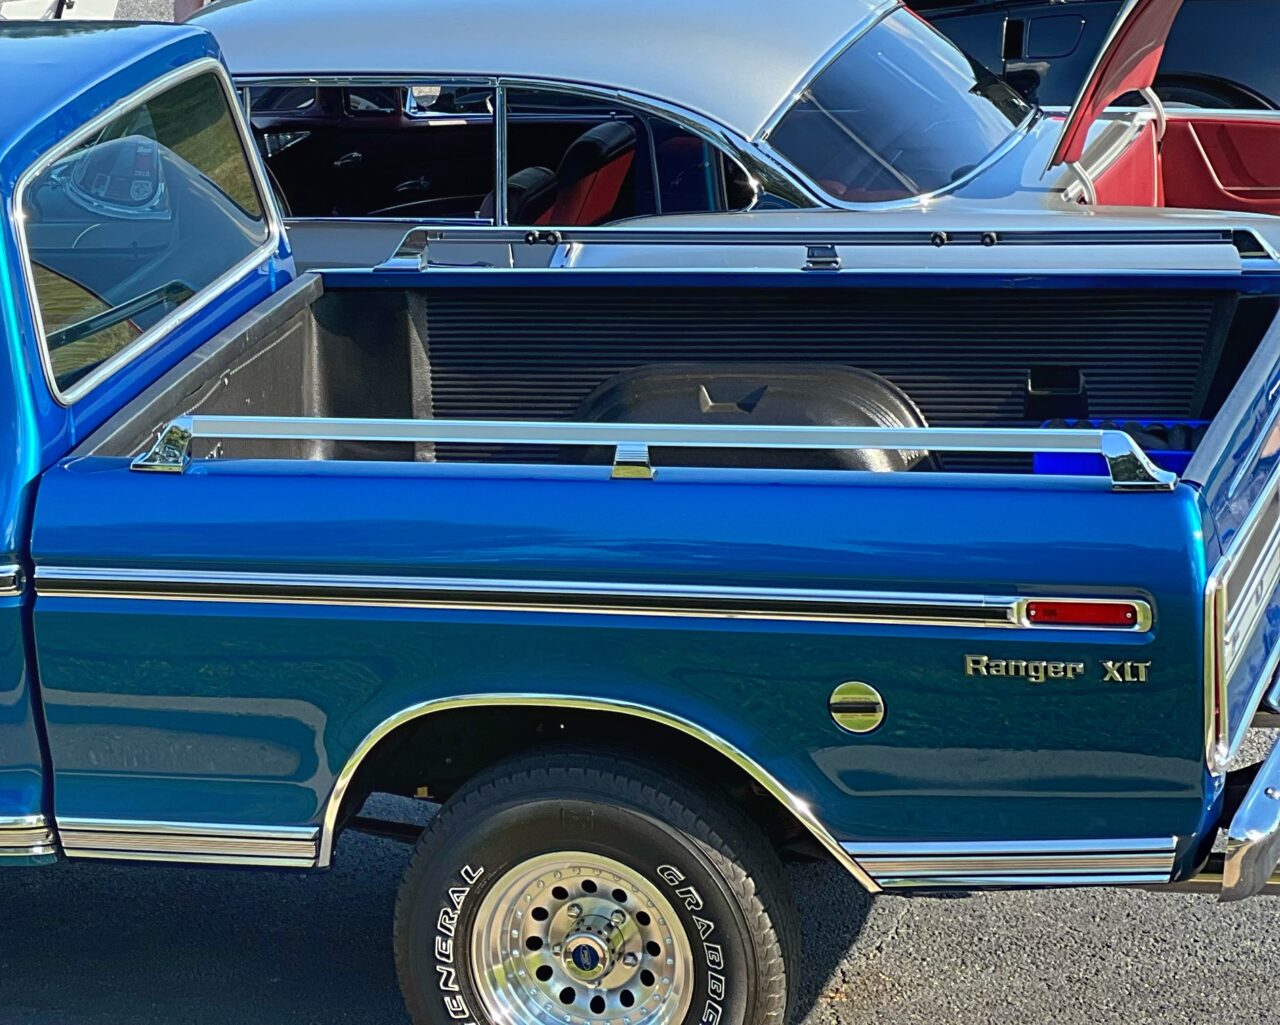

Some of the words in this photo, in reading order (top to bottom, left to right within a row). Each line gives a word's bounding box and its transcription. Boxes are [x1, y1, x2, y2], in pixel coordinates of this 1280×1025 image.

[964, 654, 1085, 683] Ranger
[1102, 659, 1152, 682] XLT
[435, 864, 485, 1025] ENERAL
[656, 864, 726, 1025] GRABBE
